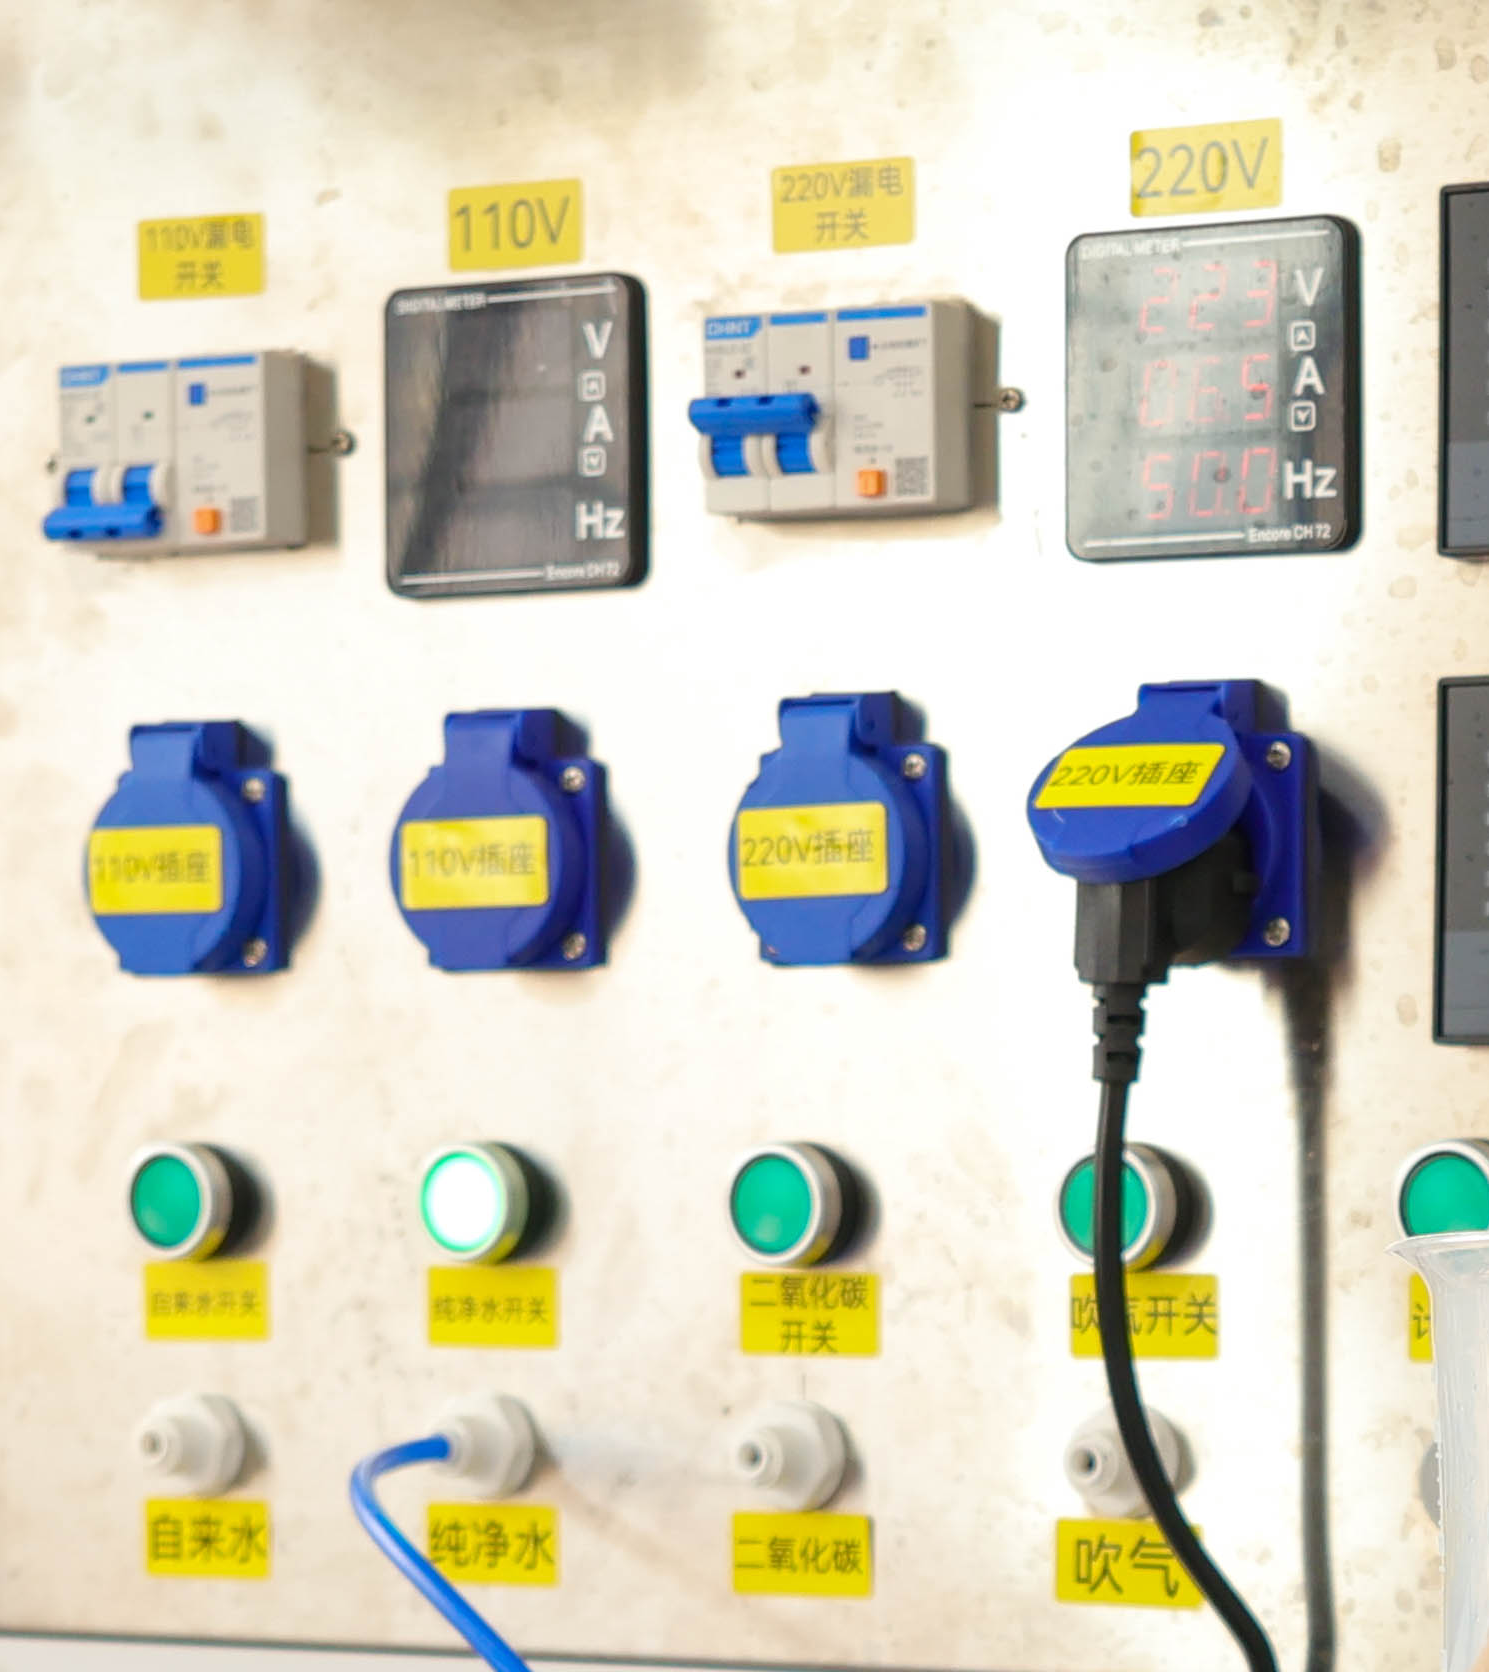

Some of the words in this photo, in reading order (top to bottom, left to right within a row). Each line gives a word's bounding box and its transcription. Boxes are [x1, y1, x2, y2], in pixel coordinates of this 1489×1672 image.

[779, 164, 904, 203] 220V漏电
[1135, 136, 1269, 200] 220V
[453, 196, 571, 253] 110V
[815, 208, 869, 242] 开关
[1135, 237, 1181, 256] METER
[1294, 267, 1325, 307] V
[582, 321, 613, 360] V
[1293, 357, 1326, 397] A
[584, 404, 614, 443] A
[1282, 460, 1338, 500] Hz
[575, 501, 626, 542] Hz
[1047, 759, 1203, 788] 220V插座
[408, 842, 538, 879] 110V插座
[742, 828, 876, 868] 220V插座
[94, 851, 212, 885] 110V插座
[432, 1294, 550, 1325] 纯净水开关
[749, 1275, 870, 1312] 二氧化碳
[780, 1320, 838, 1356] 开关
[151, 1513, 268, 1565] 自来水
[429, 1517, 556, 1572] 纯净水
[735, 1536, 864, 1577] 二氧化碳
[1075, 1535, 1180, 1601] 吹气
